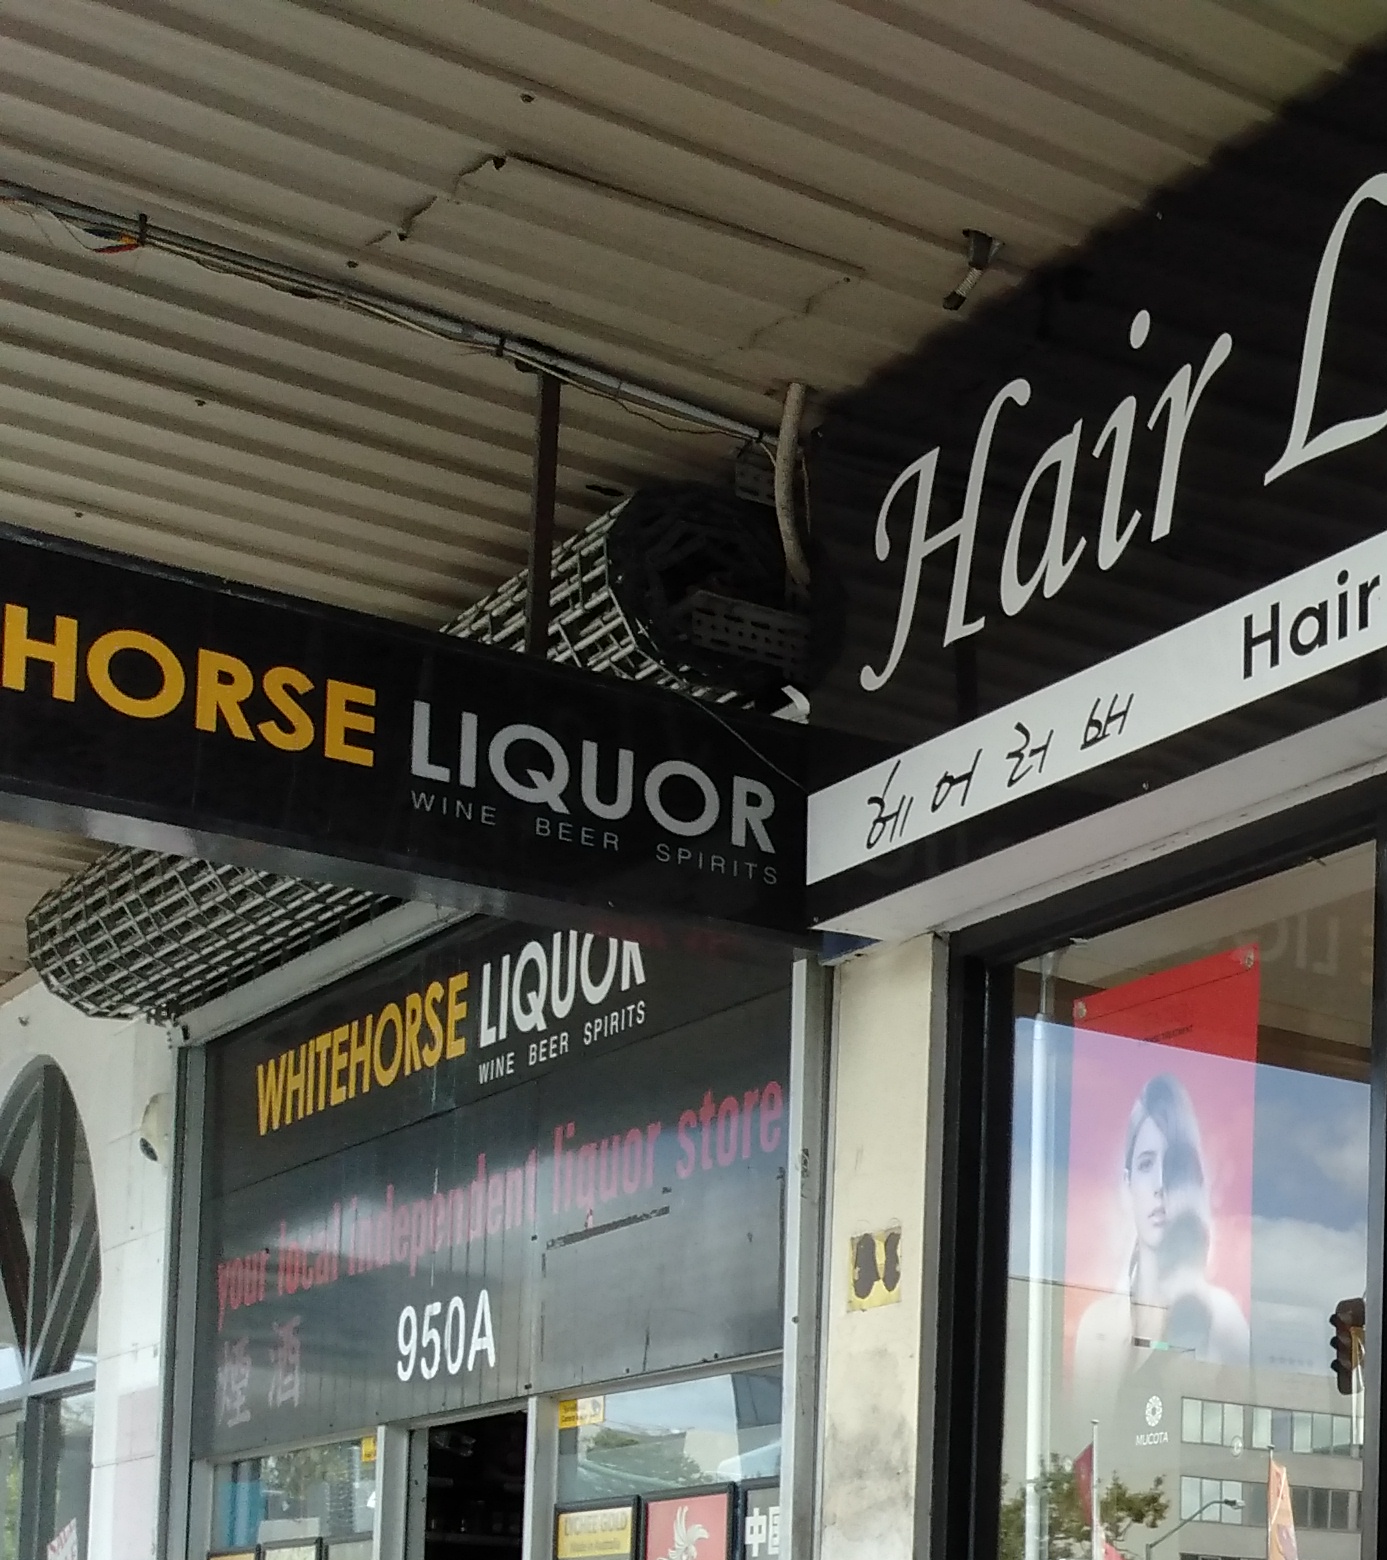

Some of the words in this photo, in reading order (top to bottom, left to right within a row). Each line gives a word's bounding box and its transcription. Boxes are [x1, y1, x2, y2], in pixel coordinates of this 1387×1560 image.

[861, 310, 1232, 692] Hair
[1242, 570, 1381, 679] Hair
[2, 605, 376, 767] HORSE
[411, 701, 776, 853] LIQUOR
[412, 790, 497, 826] WINE
[536, 818, 620, 851] BEER
[656, 847, 778, 886] SPIRITS
[257, 973, 469, 1136] WHITEHORSE
[479, 930, 646, 1050] LIQUOR
[479, 1054, 515, 1085] WINE
[530, 1035, 569, 1067] BEER
[584, 1001, 646, 1043] SPIRITS
[218, 1250, 269, 1332] your
[277, 1204, 339, 1296] local
[347, 1148, 538, 1277] independent
[552, 1121, 661, 1229] liquor
[677, 1081, 783, 1179] store
[397, 1290, 496, 1381] 950A
[1136, 1432, 1168, 1445] MUCOTA
